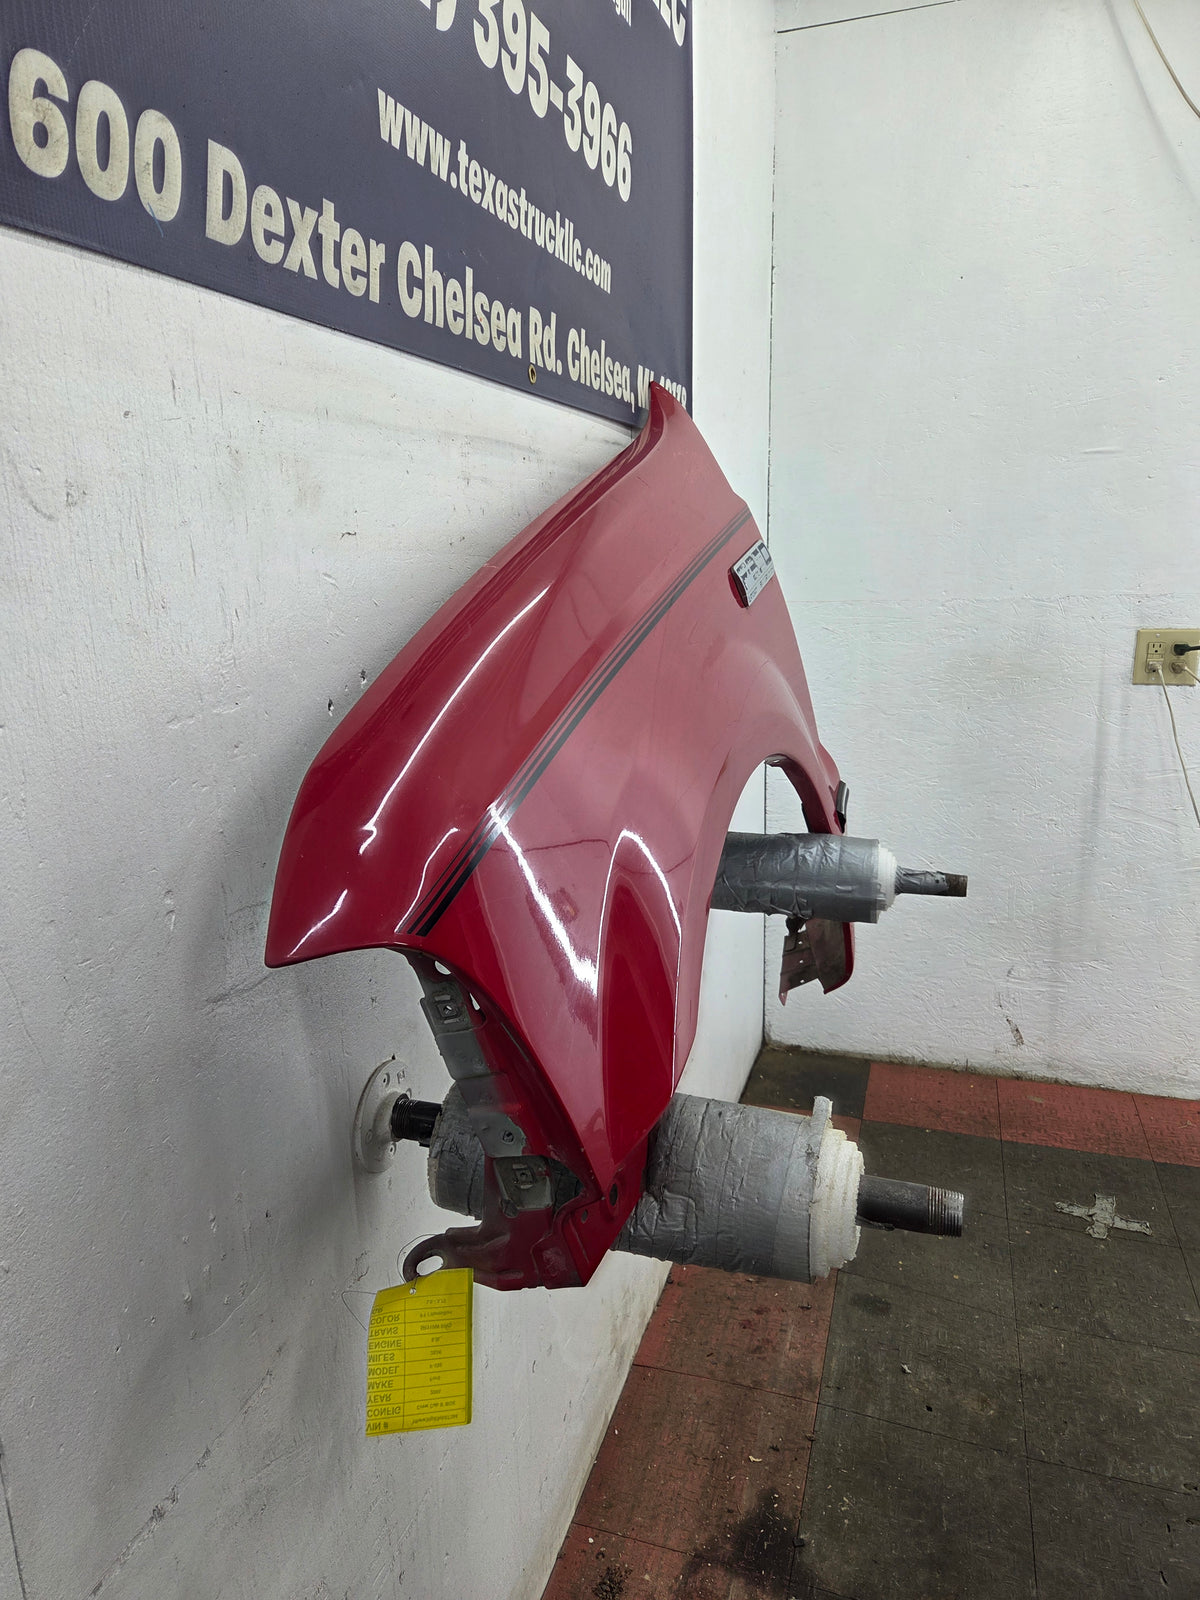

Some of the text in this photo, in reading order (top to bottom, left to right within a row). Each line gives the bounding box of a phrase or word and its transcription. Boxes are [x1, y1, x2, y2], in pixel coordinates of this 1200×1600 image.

[377, 87, 612, 295] www.texastruckllc.com
[472, 0, 633, 203] 395-3966
[8, 48, 655, 413] 600 Dexter Chelsea Rd. Chelsea, M
